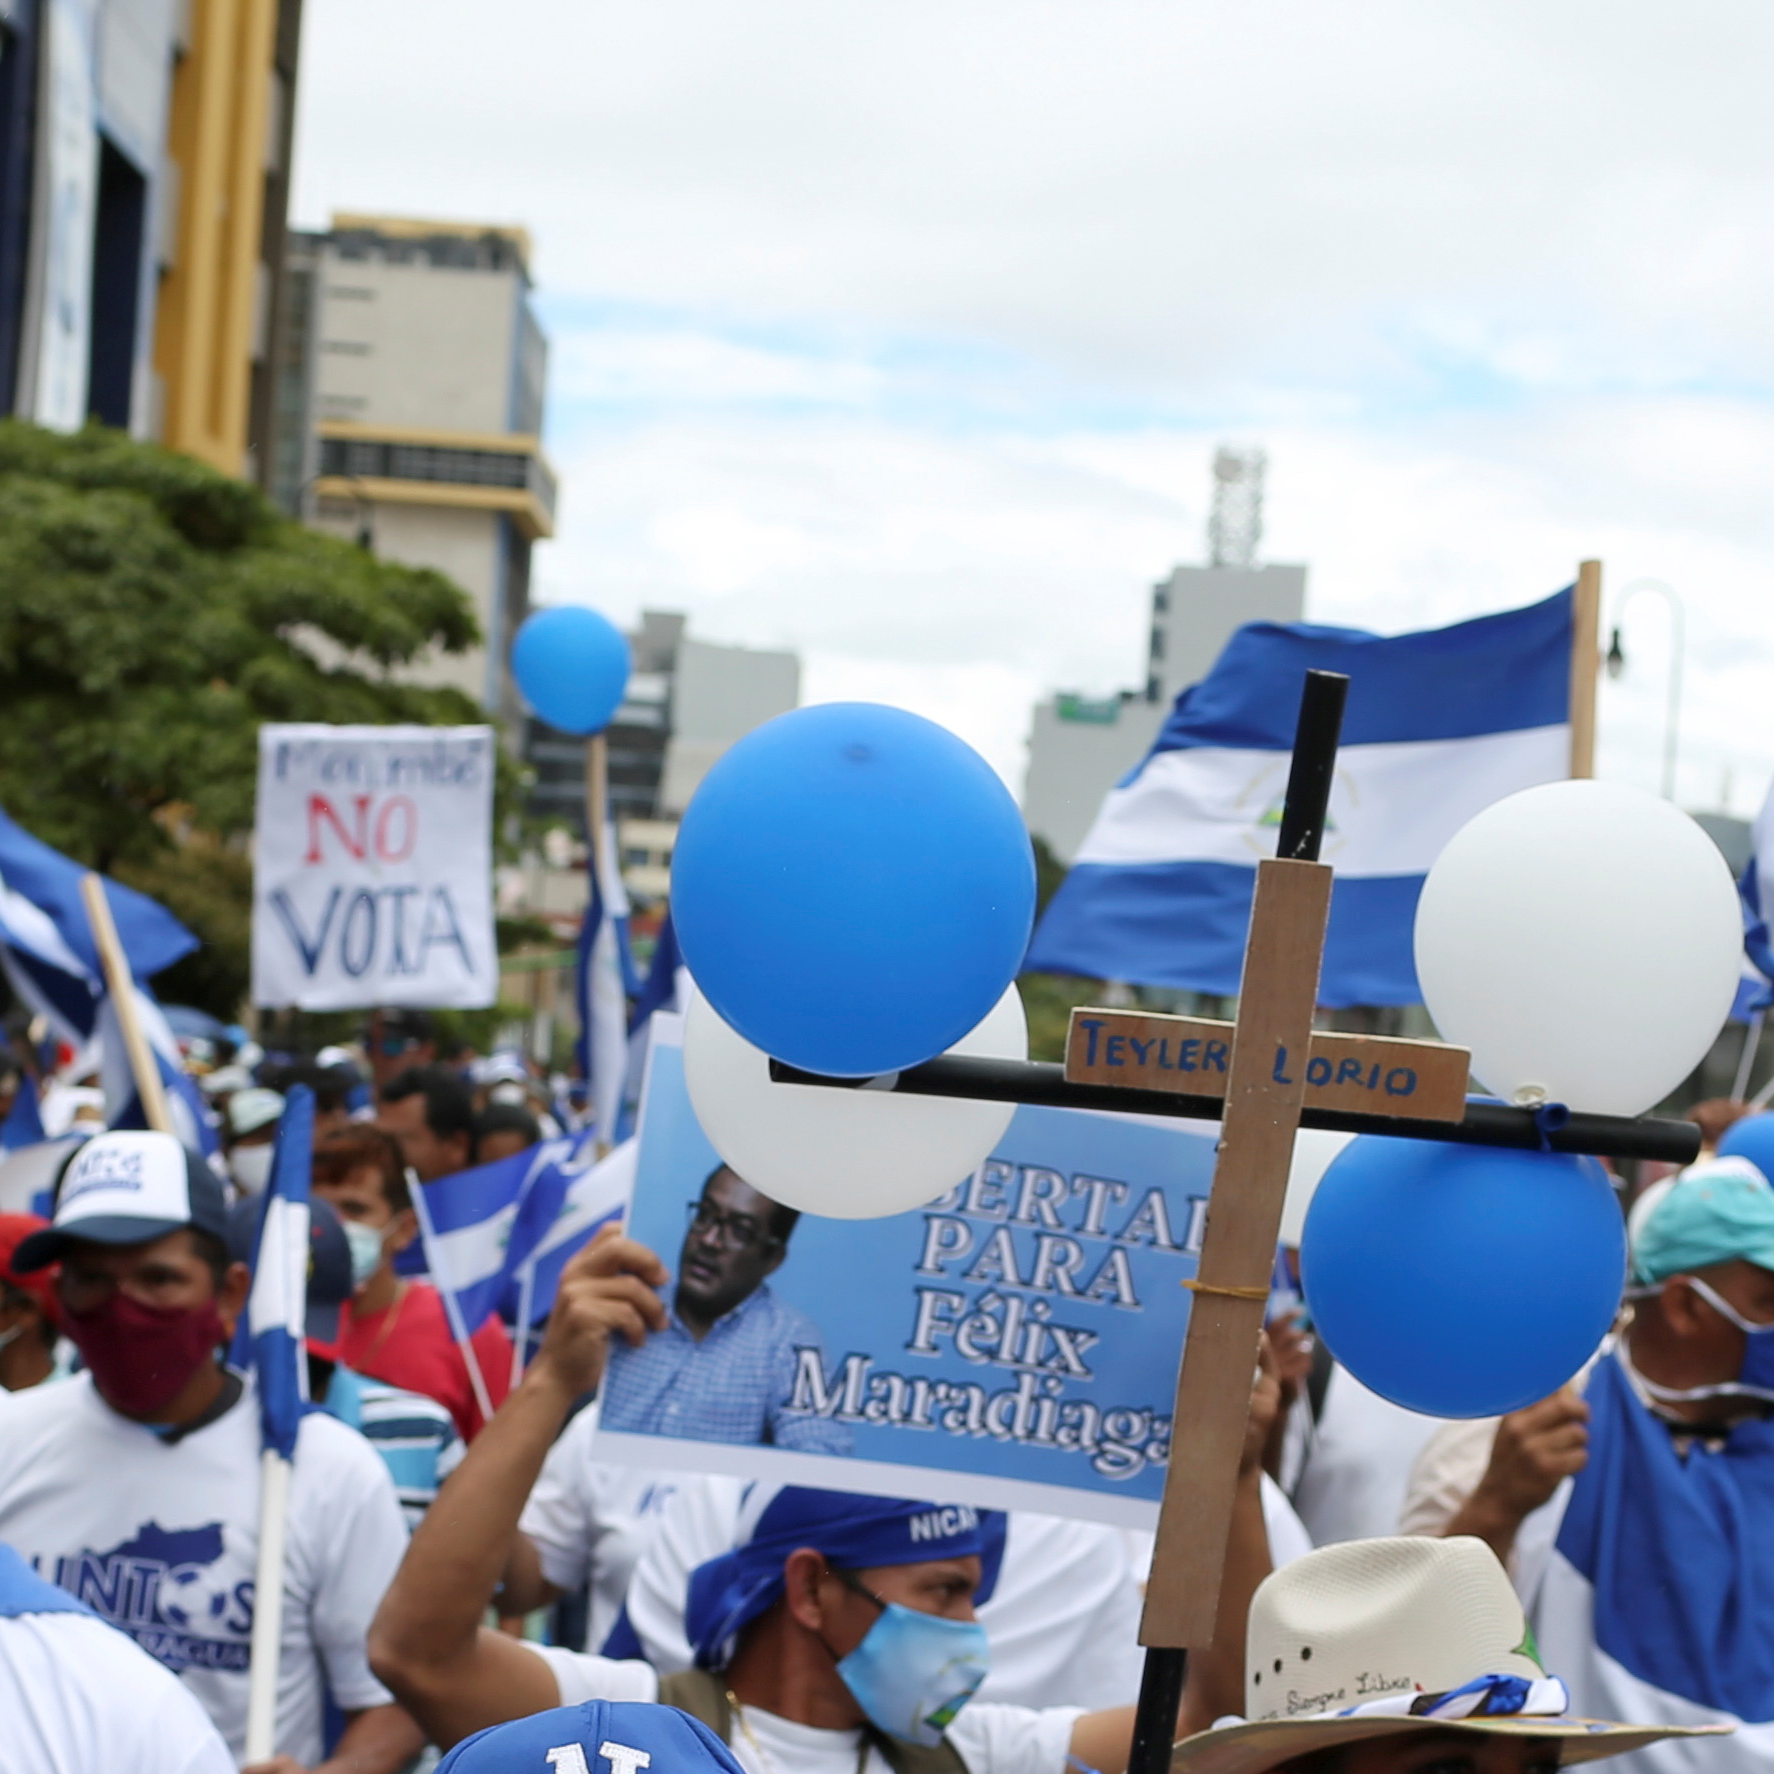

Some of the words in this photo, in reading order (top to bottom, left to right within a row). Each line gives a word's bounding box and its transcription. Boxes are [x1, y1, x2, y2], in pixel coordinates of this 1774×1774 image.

[304, 790, 419, 868] NO
[267, 884, 482, 980] VOTA
[1079, 1018, 1227, 1073] TEYLER
[1272, 1046, 1418, 1097] LORIO
[913, 1213, 1143, 1312] PARA
[903, 1284, 1100, 1382] Félix
[1355, 1670, 1412, 1696] Libre
